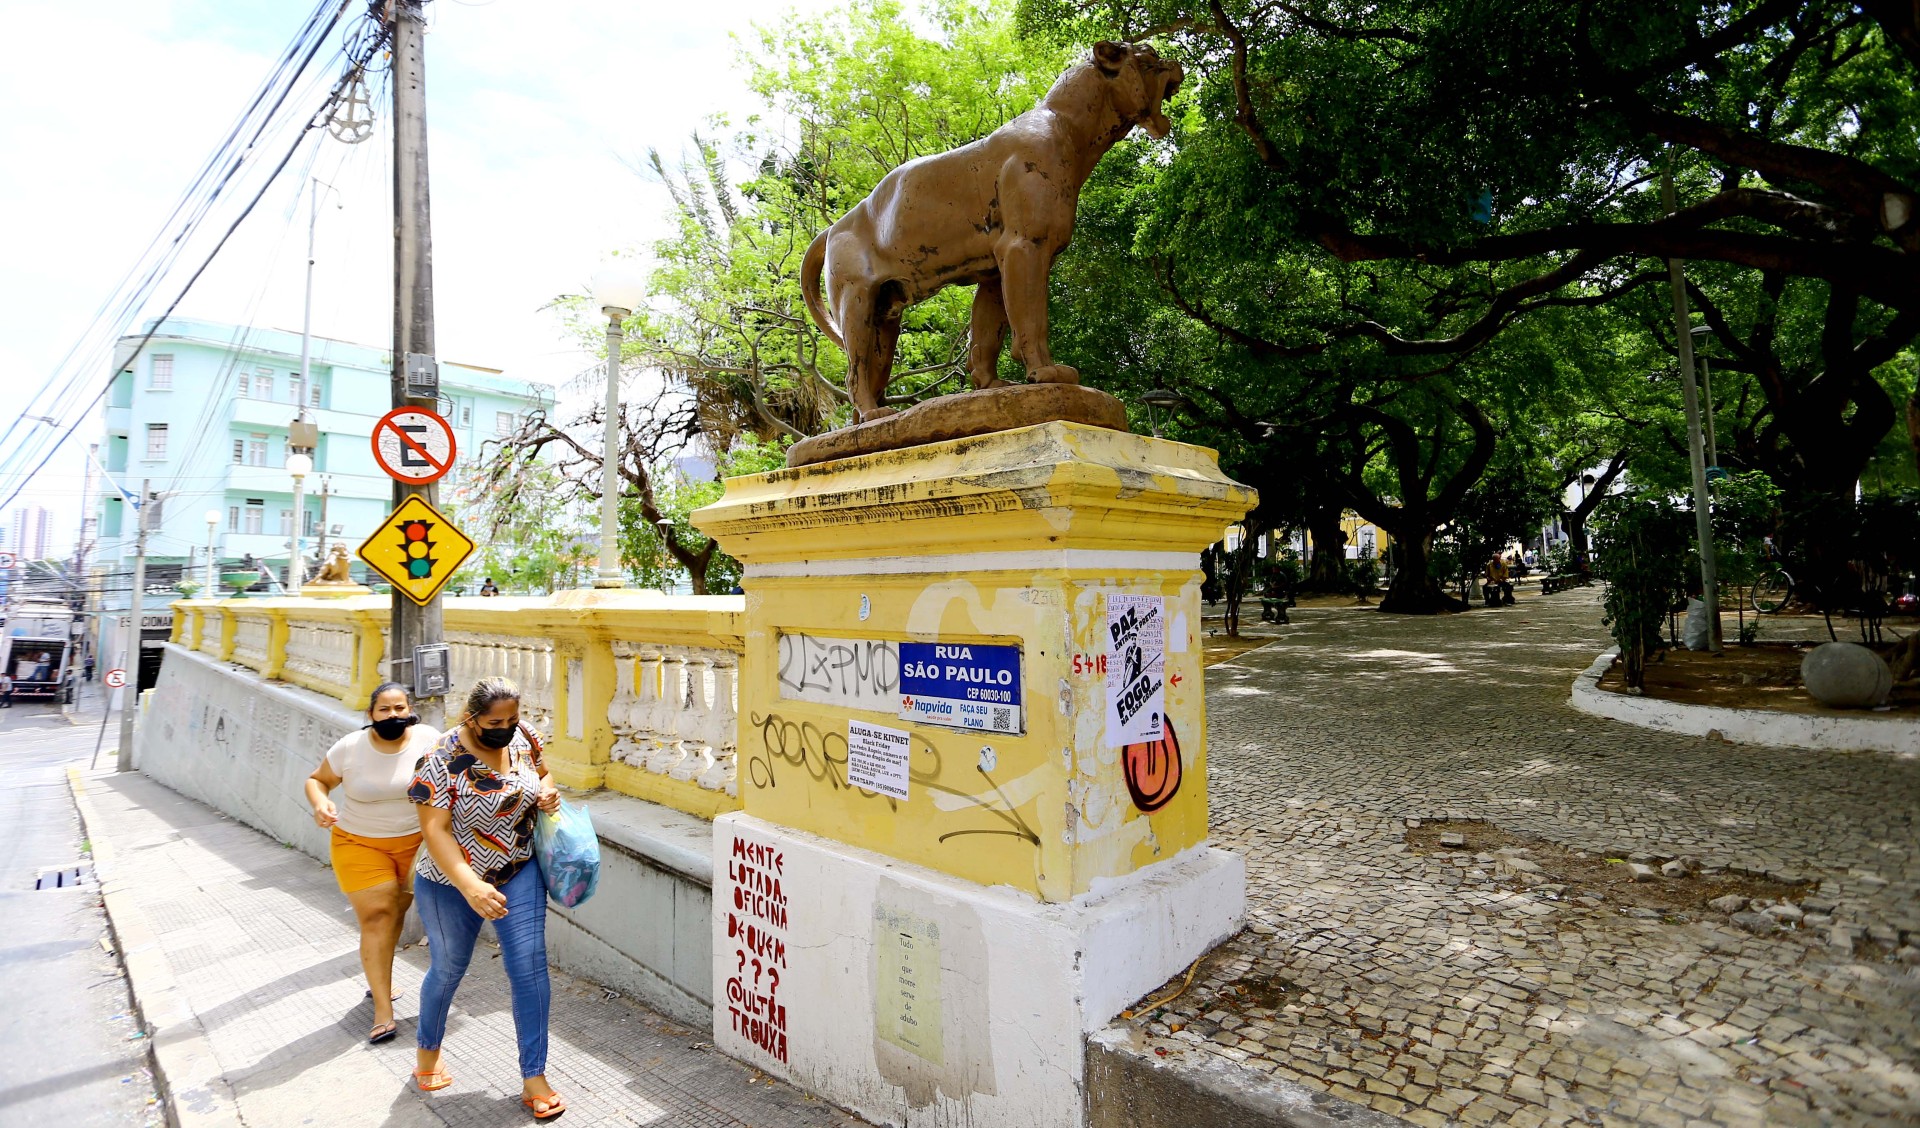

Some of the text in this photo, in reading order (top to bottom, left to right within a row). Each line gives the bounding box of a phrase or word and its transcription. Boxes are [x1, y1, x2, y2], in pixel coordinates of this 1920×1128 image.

[1110, 606, 1138, 642] PAZ
[1114, 631, 1131, 651] ENTRE
[1138, 606, 1158, 629] PRETOS
[935, 645, 972, 660] RUA
[904, 661, 1012, 685] SÃO PAULO
[967, 687, 1011, 702] CEP 60030-100
[1116, 675, 1151, 719] FOGO
[914, 699, 952, 714] hapvida
[960, 704, 988, 715] FAÇA SEU
[1120, 717, 1129, 726] NA
[1128, 701, 1143, 718] CASA
[1142, 679, 1162, 703] GRANDE
[963, 718, 984, 728] PLANO
[850, 727, 909, 745] ALUGA-SE KITNET
[876, 741, 890, 751] Friday
[733, 836, 783, 877] MENTE
[729, 860, 787, 906] LOTADA,
[734, 886, 787, 931] OFICINA
[900, 938, 914, 950] Tudo
[901, 965, 912, 975] que
[899, 976, 916, 988] morre
[900, 989, 915, 1001] serve
[727, 977, 786, 1032] @ULTRA
[904, 1002, 912, 1011] de
[900, 1013, 918, 1027] adubo
[729, 1006, 787, 1064] TROUXA
